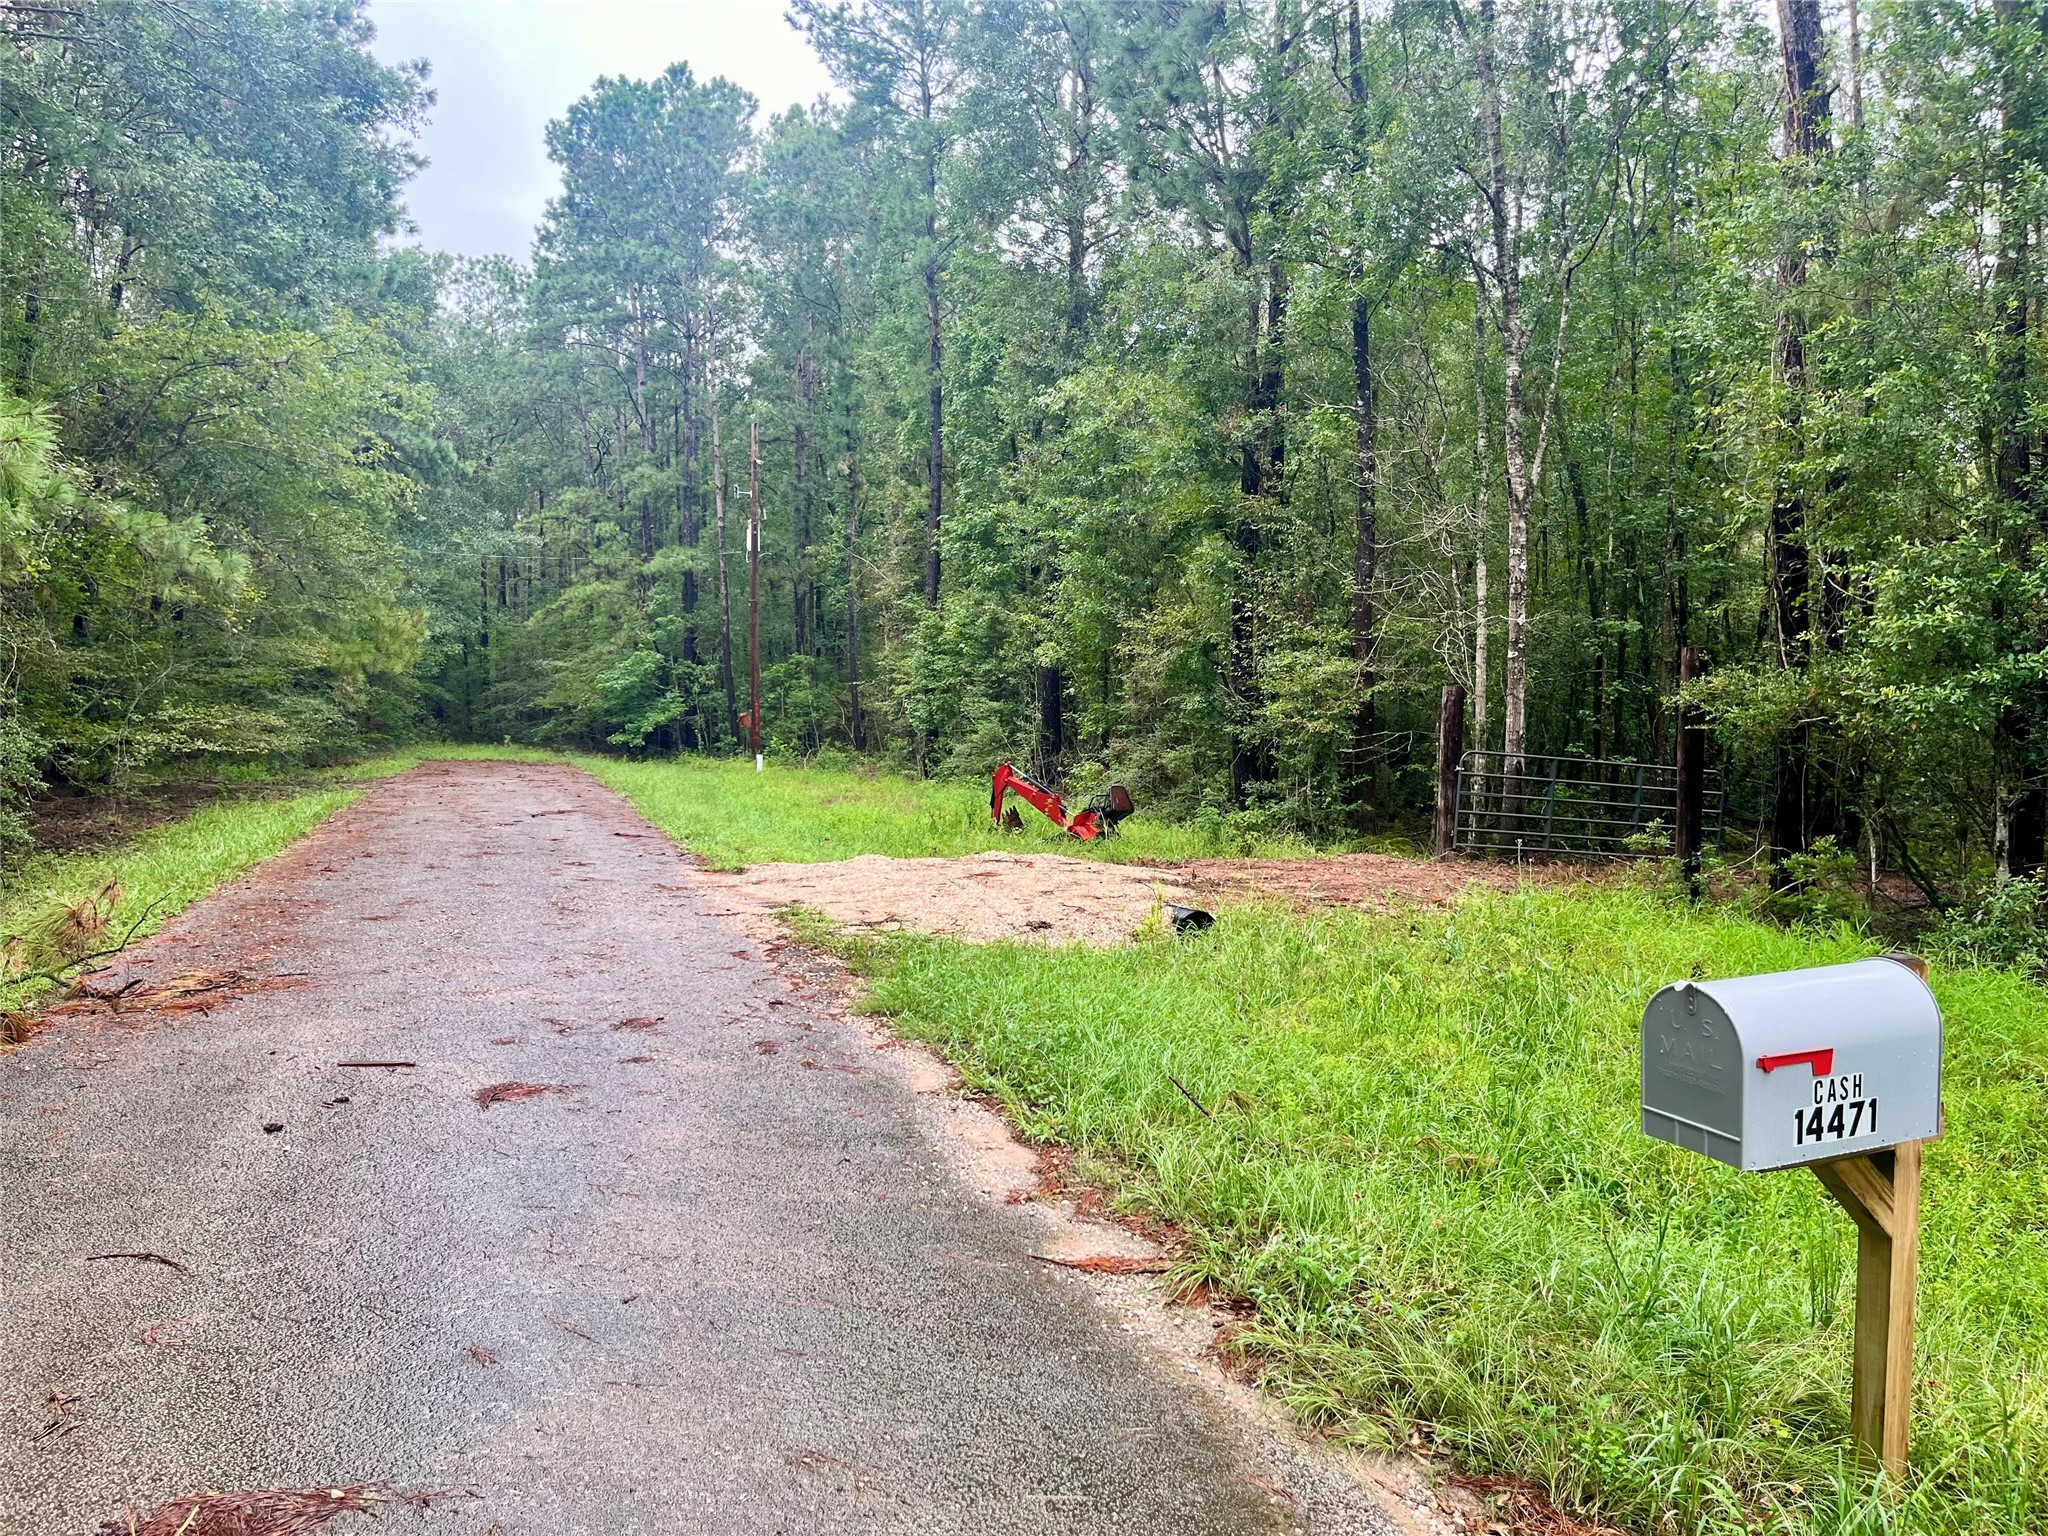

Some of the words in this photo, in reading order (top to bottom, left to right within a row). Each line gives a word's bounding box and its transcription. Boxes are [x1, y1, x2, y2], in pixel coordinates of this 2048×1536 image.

[1660, 1034, 1723, 1070] MAIL
[1814, 1073, 1862, 1105] CASH
[1794, 1097, 1878, 1146] 14471
